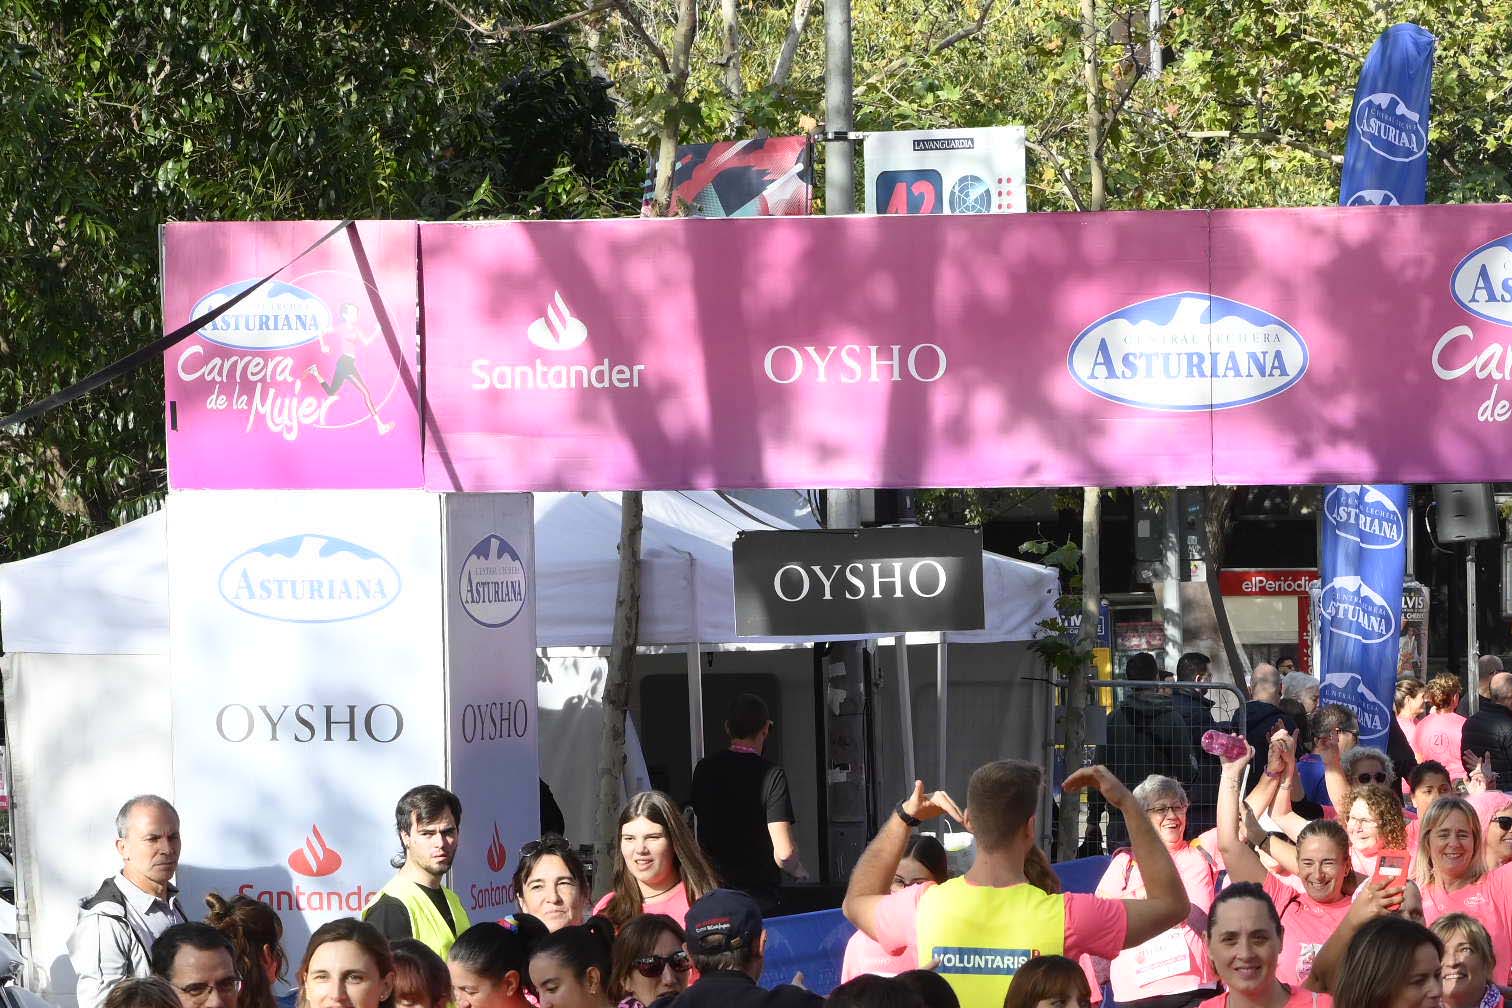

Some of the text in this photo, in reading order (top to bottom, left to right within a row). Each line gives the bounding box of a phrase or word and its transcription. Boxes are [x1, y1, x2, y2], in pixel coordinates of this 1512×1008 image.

[177, 345, 293, 382] Carrera
[471, 358, 645, 390] Santander
[763, 343, 947, 384] OYSHO
[1087, 337, 1290, 381] ASTURIANA
[207, 379, 339, 441] de la Mujer
[1478, 384, 1511, 422] de
[231, 567, 388, 601] ASTURIANA
[464, 569, 523, 604] ASTURIANA
[773, 560, 947, 602] OYSHO
[1242, 576, 1313, 592] elPeriódi
[1401, 596, 1424, 609] LVIS
[216, 704, 404, 742] OYSHO
[462, 699, 528, 744] OYSHO
[935, 951, 1029, 970] VOLUNTARIS
